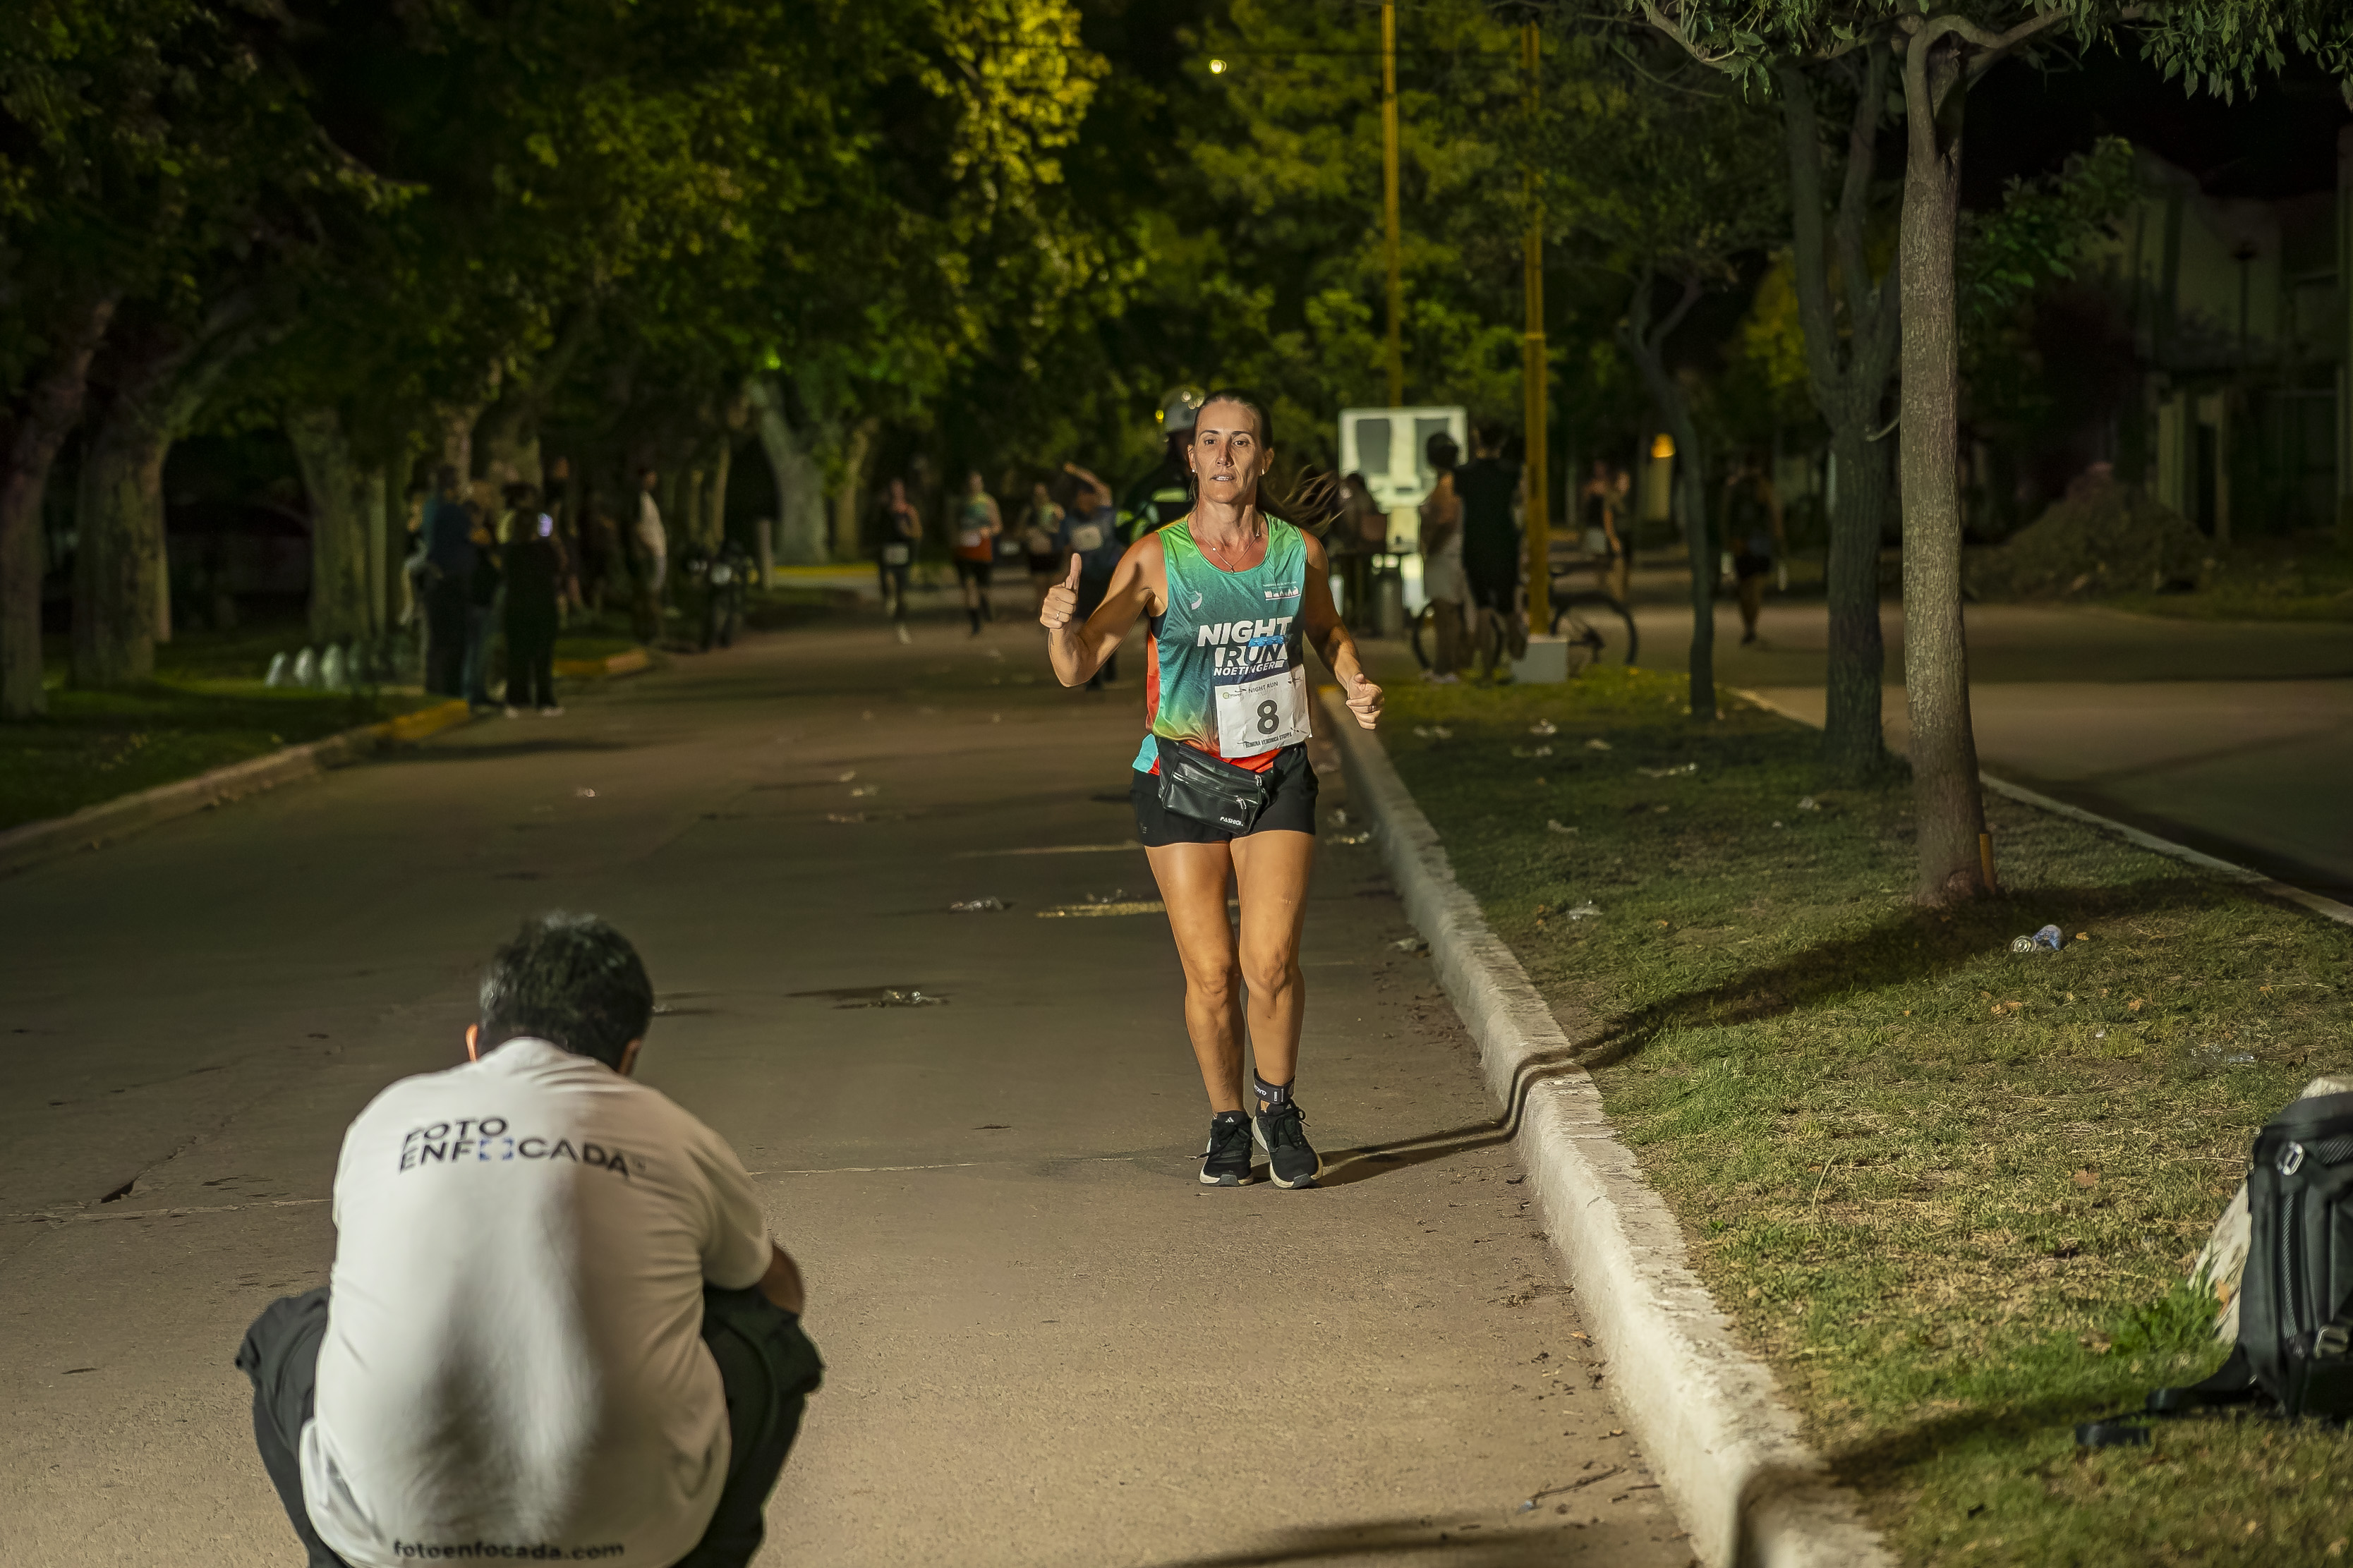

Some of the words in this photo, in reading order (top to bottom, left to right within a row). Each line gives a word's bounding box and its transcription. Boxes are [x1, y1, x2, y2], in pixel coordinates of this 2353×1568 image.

[1197, 616, 1293, 647] NIGHT
[1218, 643, 1286, 667] RUN
[1214, 662, 1276, 676] NOETINGER
[1248, 684, 1266, 693] NIGHT
[1257, 699, 1280, 735] 8
[403, 1117, 509, 1148] FOTO
[392, 1538, 625, 1561] fotoenfocada.com
